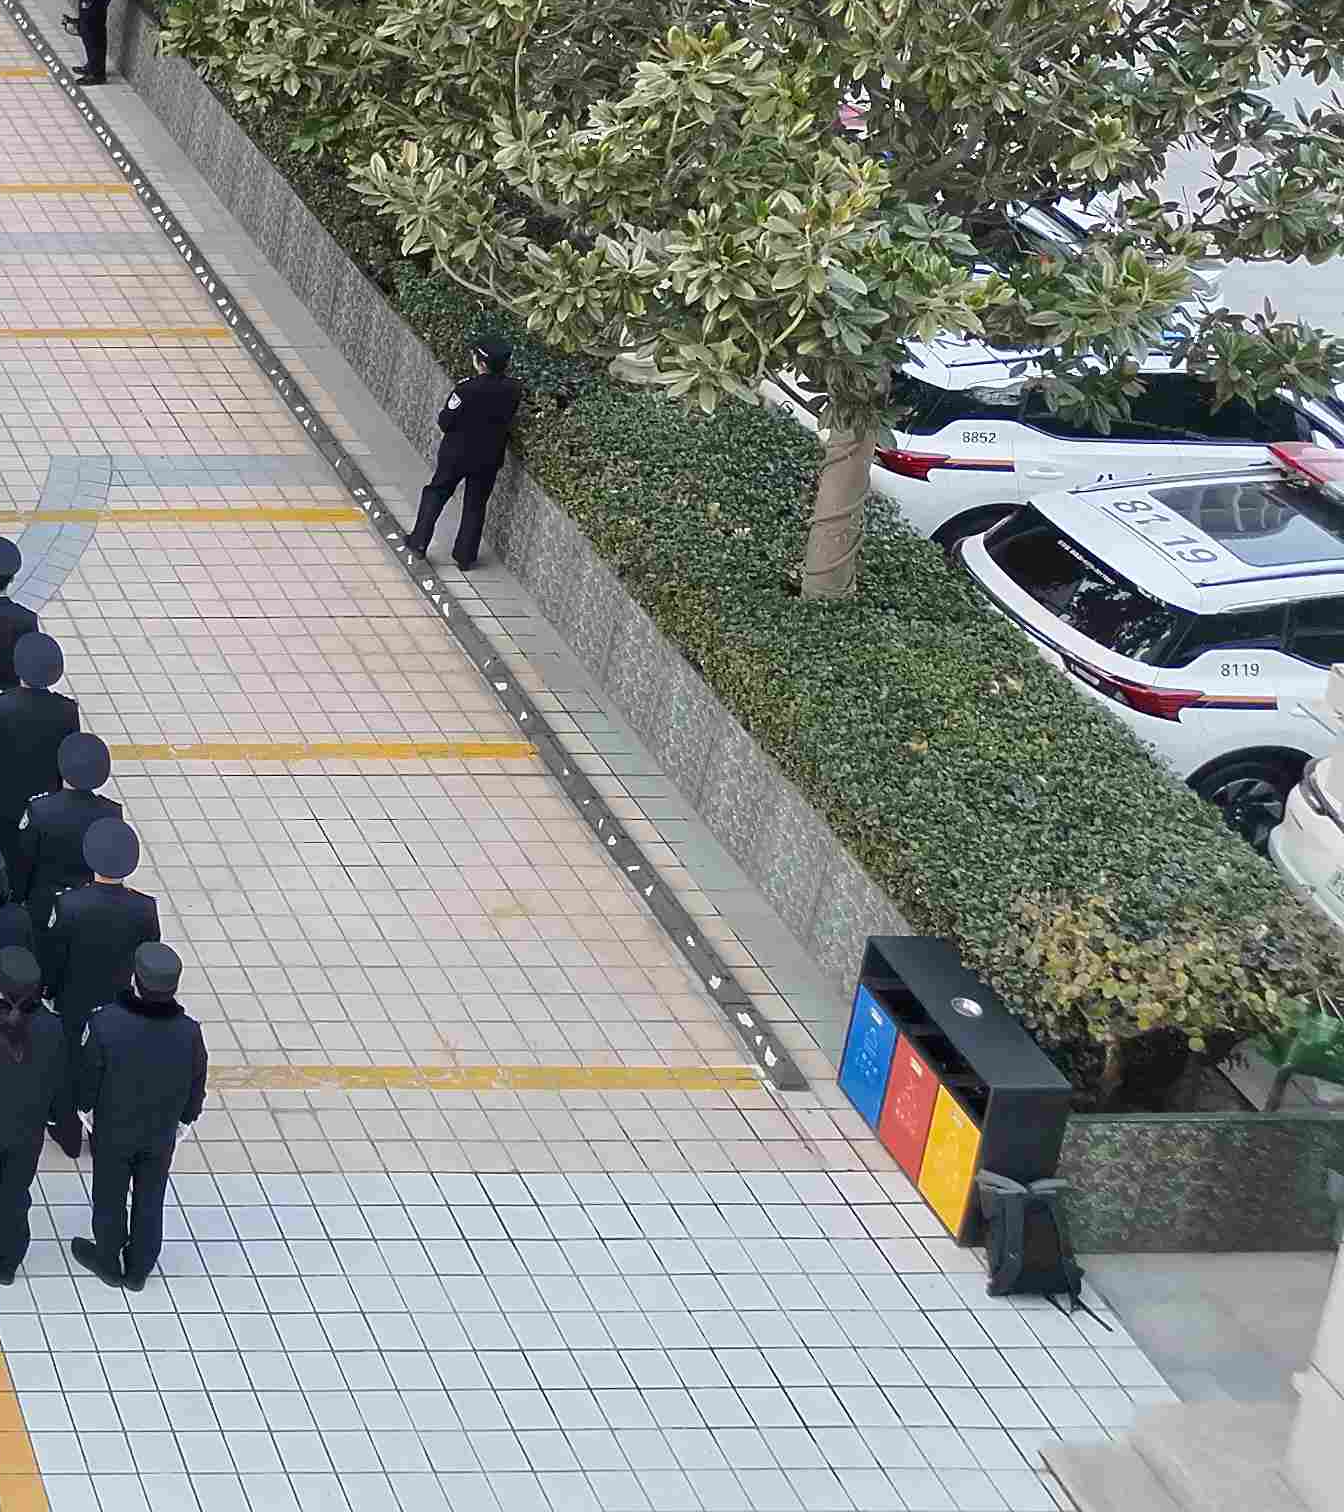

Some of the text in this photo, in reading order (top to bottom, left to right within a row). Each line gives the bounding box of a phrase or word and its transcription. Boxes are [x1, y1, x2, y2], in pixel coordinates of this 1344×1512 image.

[962, 431, 998, 444] 8852
[1113, 500, 1218, 563] 8119
[1220, 663, 1260, 677] 8119
